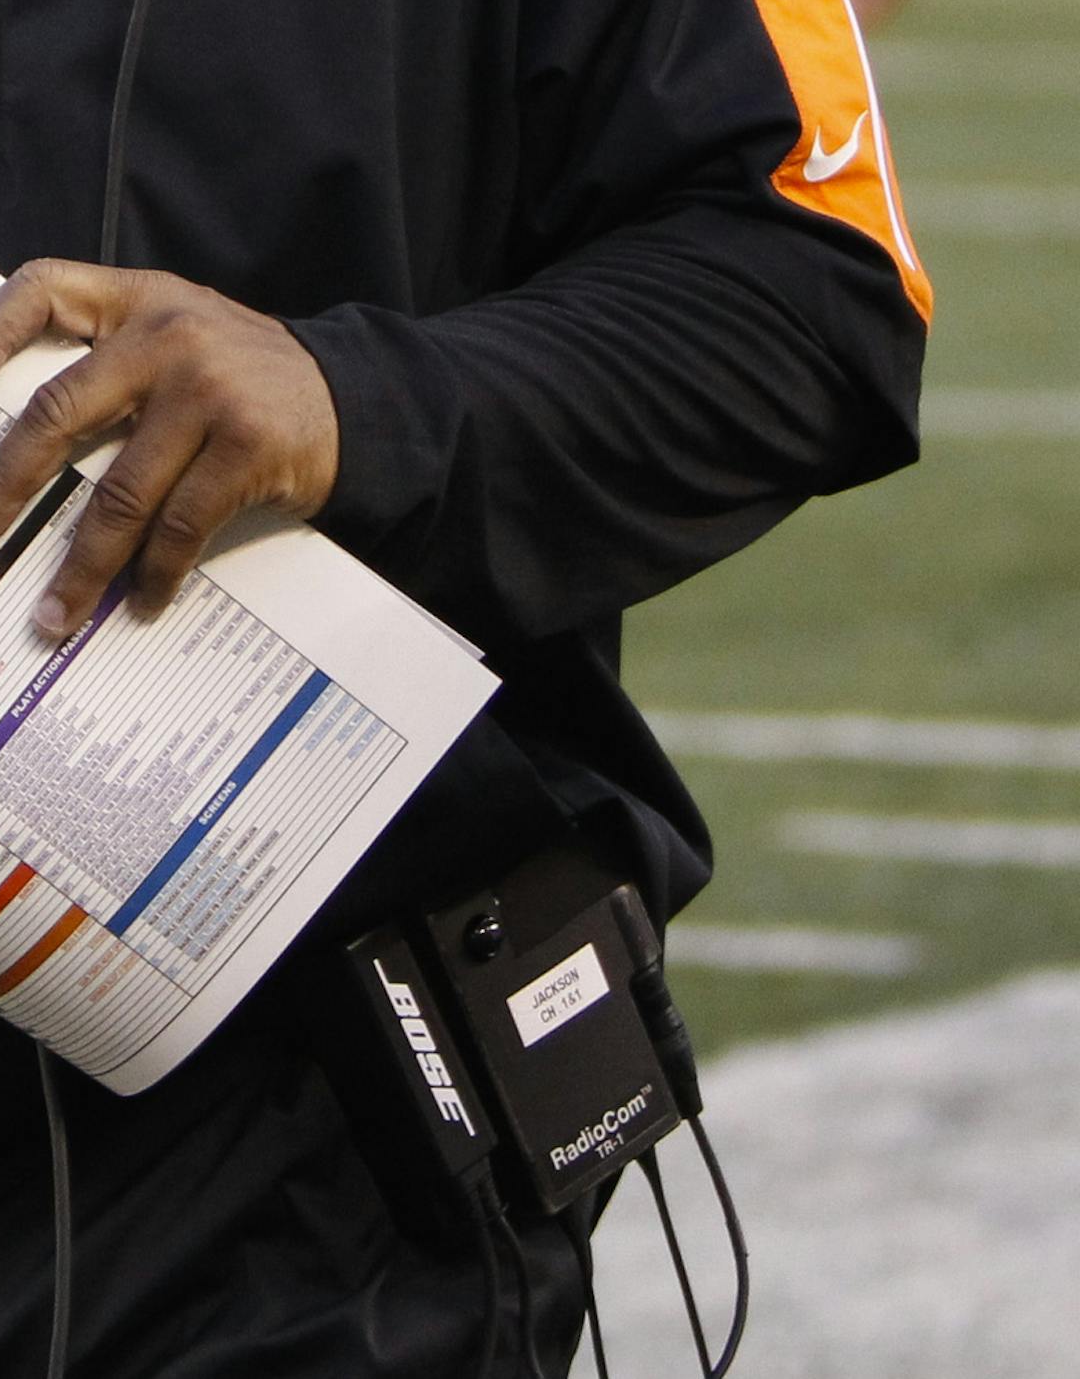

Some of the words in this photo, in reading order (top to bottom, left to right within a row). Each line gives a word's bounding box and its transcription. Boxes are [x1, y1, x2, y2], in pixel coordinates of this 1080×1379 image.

[9, 689, 35, 718] PLAY
[29, 654, 64, 693] ACTION
[58, 617, 95, 658] PASSES
[197, 779, 238, 826] SCREENS
[532, 967, 580, 1009] JACKSON
[373, 958, 475, 1137] BOSE
[595, 1133, 625, 1159] TR-1
